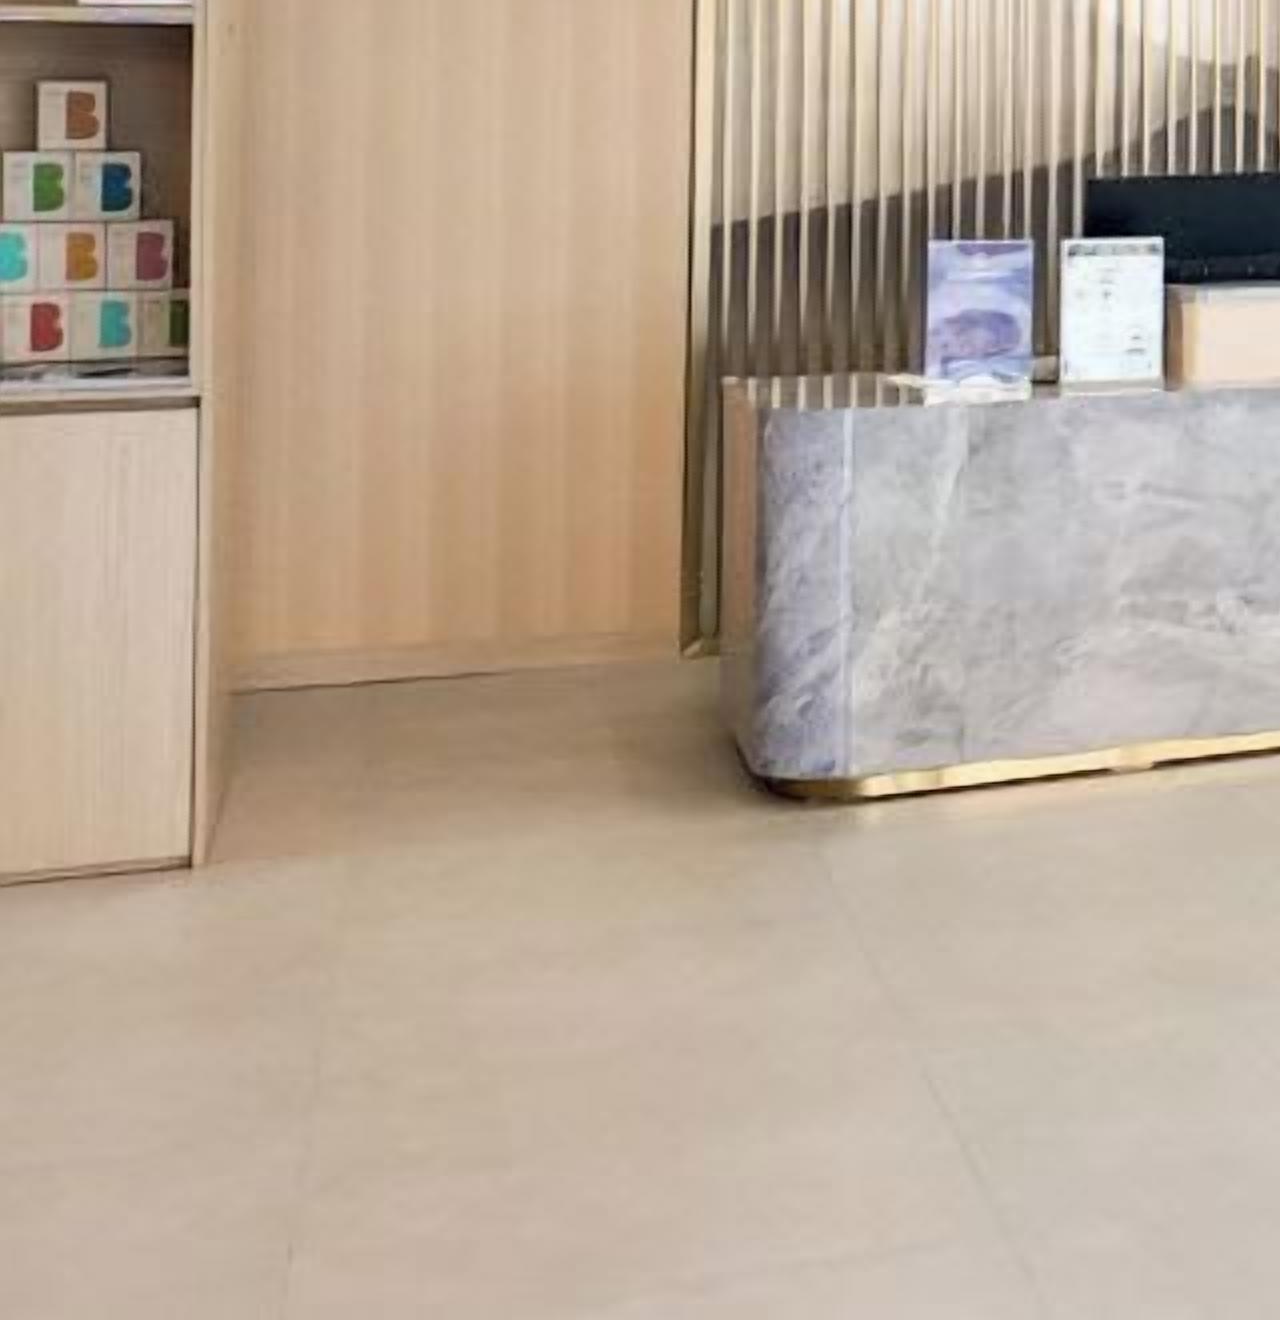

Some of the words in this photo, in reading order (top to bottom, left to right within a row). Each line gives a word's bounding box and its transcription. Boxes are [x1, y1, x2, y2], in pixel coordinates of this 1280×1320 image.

[66, 91, 99, 139] B
[33, 163, 64, 212] B
[101, 163, 132, 212] B
[66, 232, 98, 281] B
[136, 232, 168, 280] B
[31, 303, 63, 352] B
[100, 300, 132, 348] B
